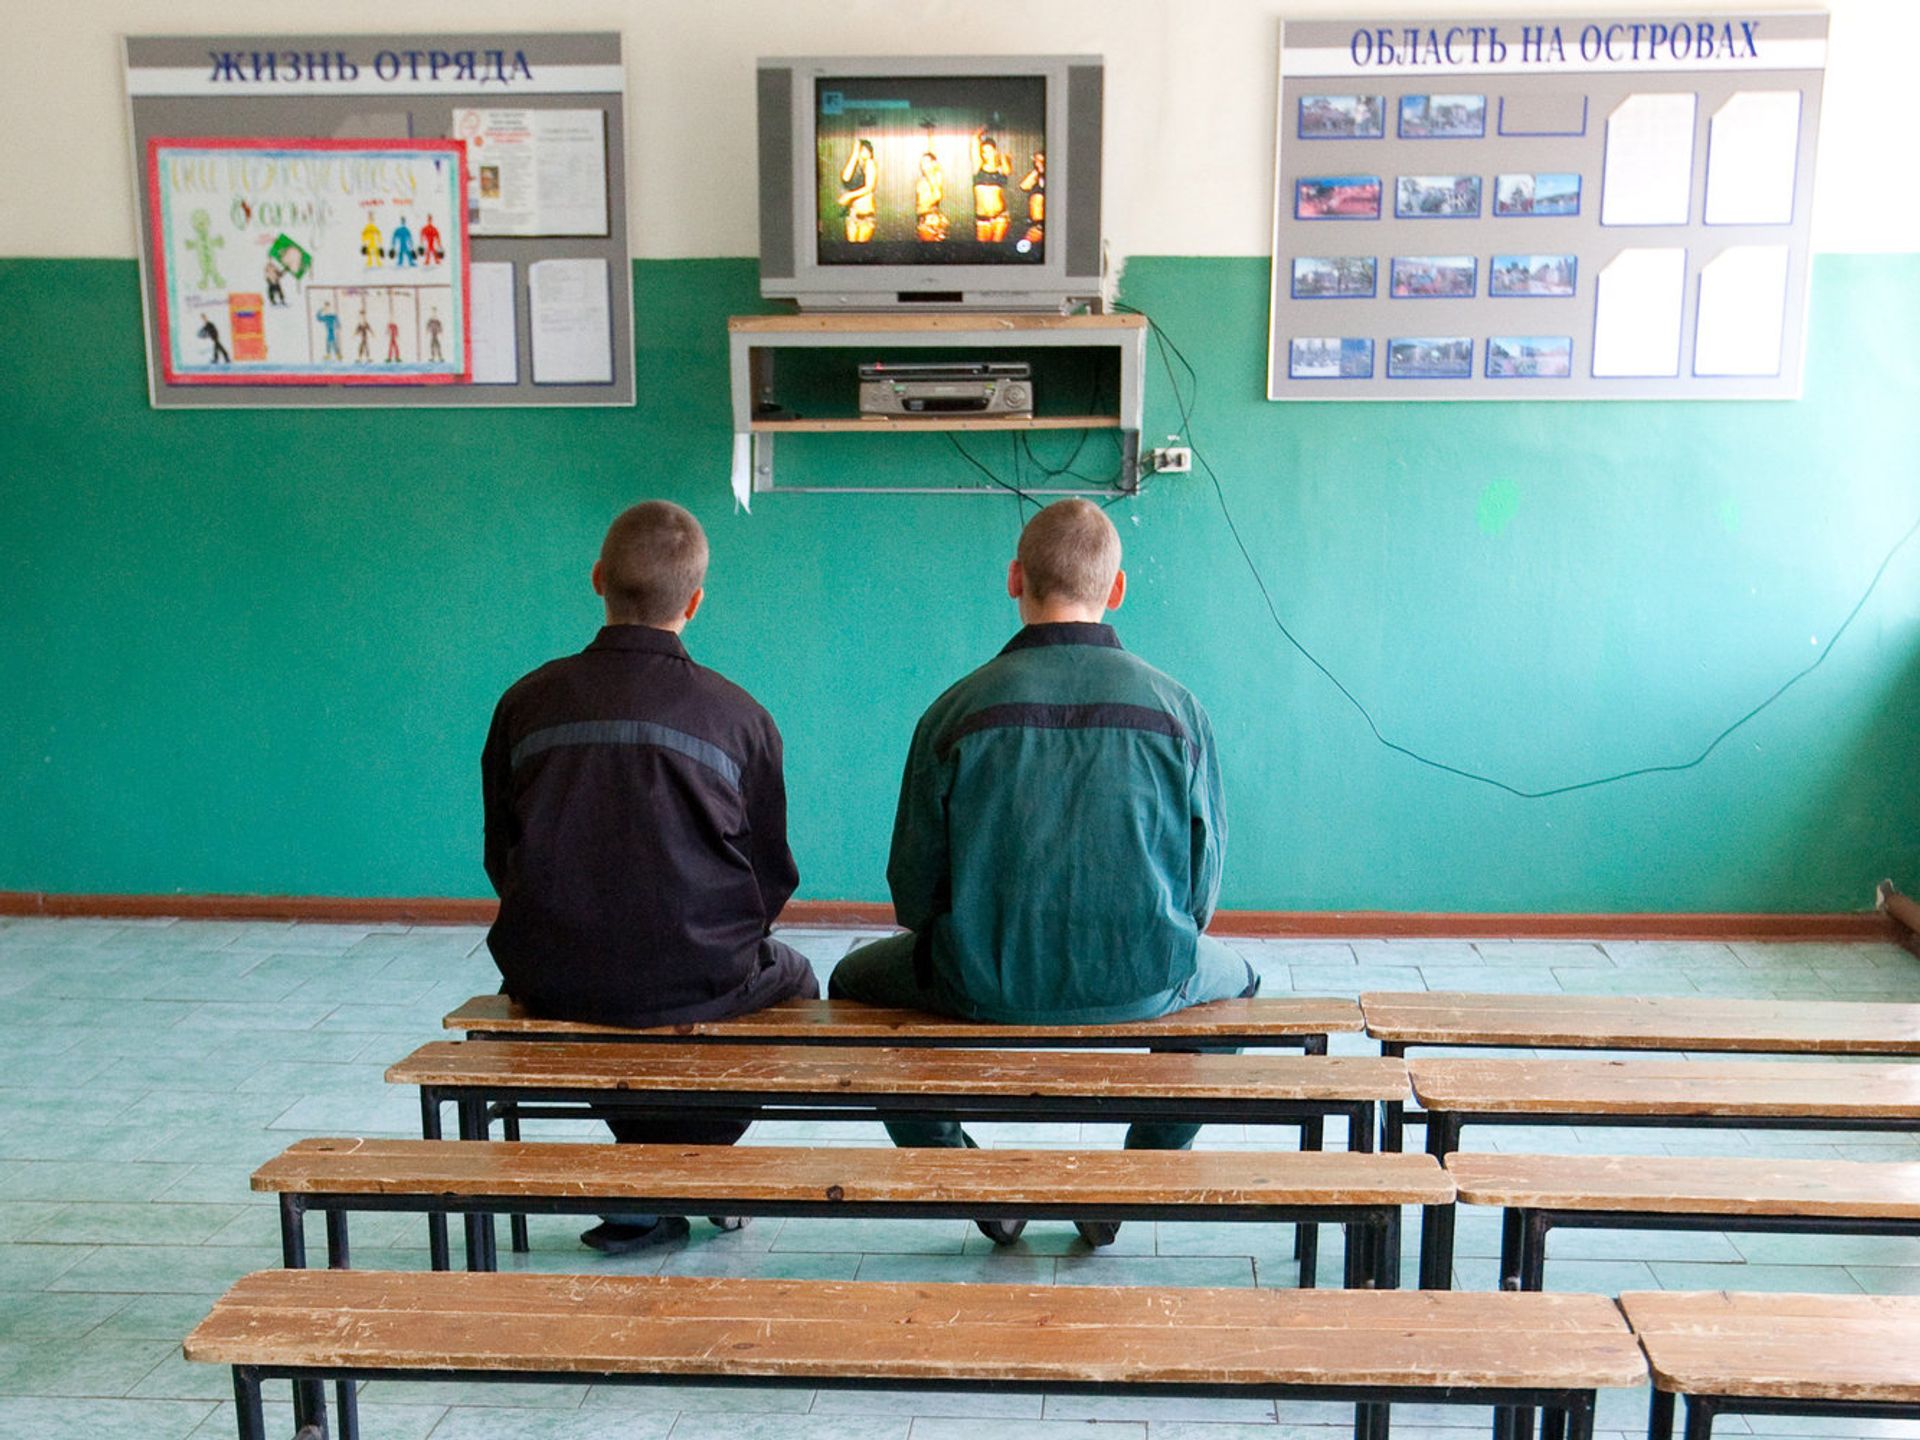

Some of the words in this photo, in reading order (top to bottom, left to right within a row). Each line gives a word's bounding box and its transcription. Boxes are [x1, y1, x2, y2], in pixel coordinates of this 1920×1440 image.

[1351, 26, 1507, 66] ОБЛАСТЬ
[1522, 24, 1566, 62] НА
[1580, 21, 1759, 62] ОСТРОВАХ
[209, 52, 358, 82] ЖИЗНЬ
[374, 50, 532, 84] ОТРЯДА
